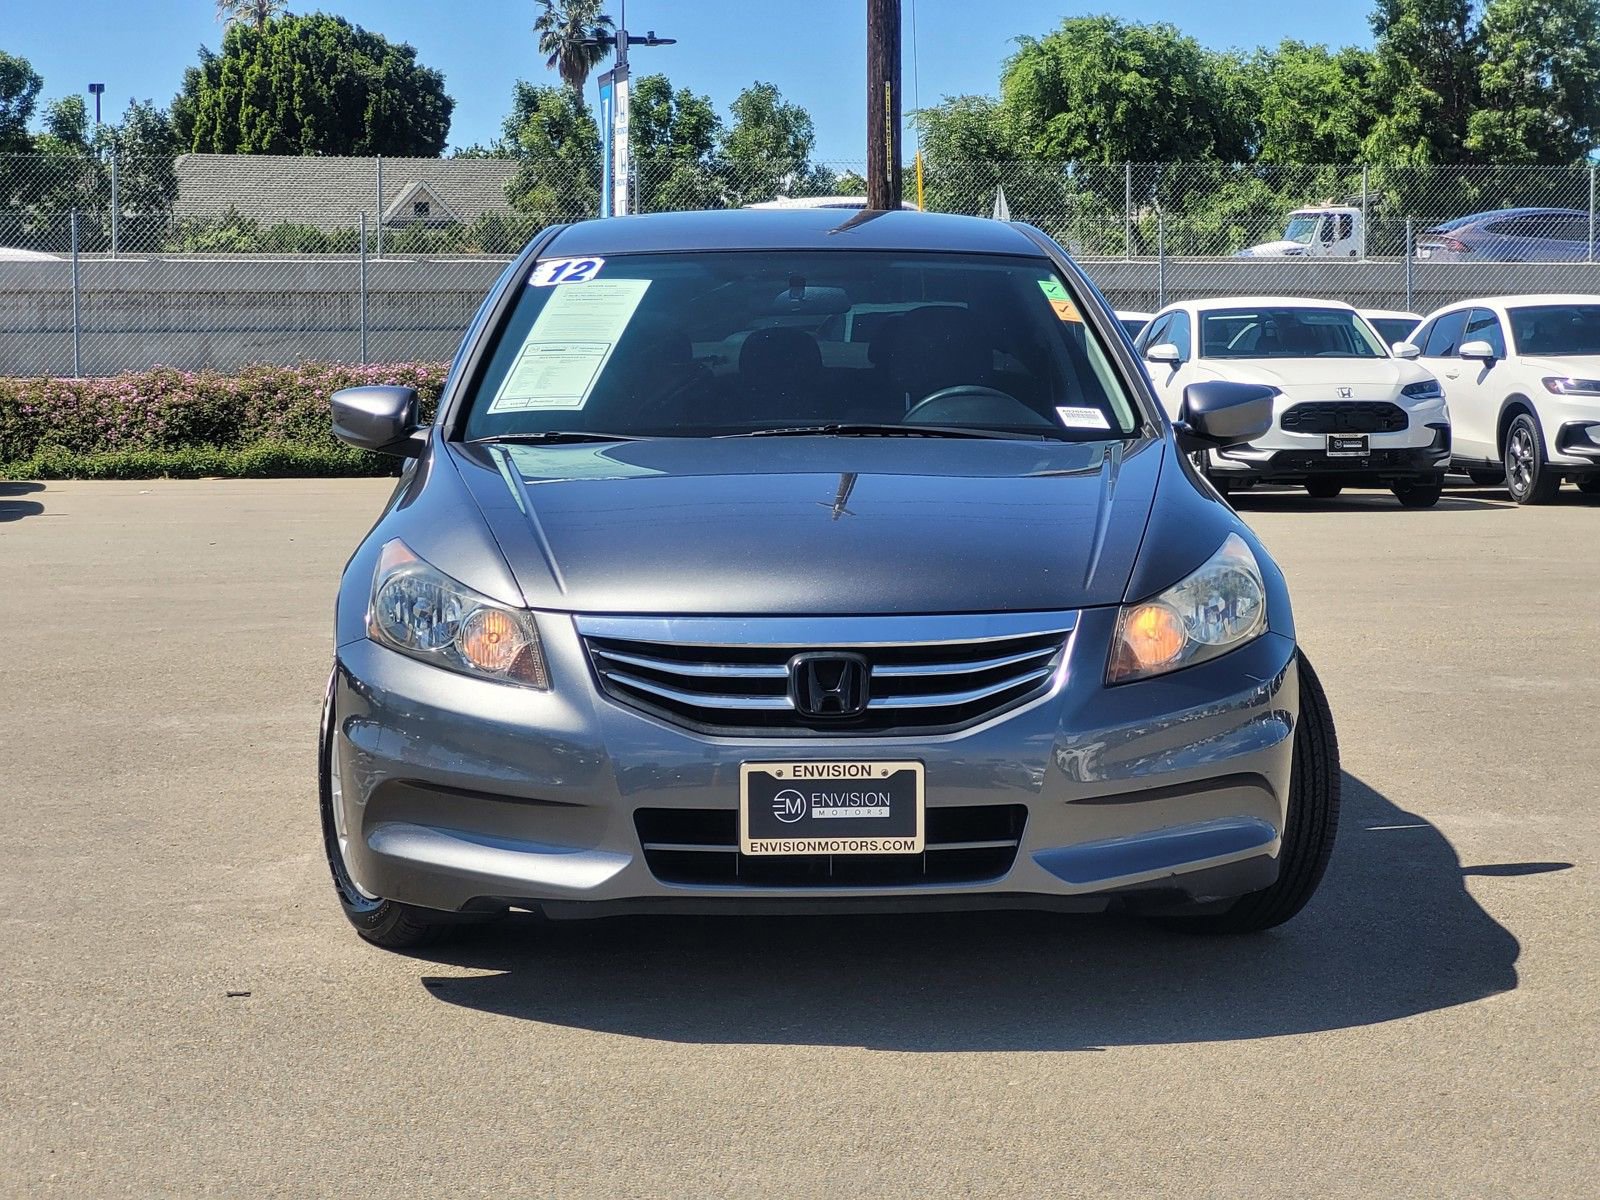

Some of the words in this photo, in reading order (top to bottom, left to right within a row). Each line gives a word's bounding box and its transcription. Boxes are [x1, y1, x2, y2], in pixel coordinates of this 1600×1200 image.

[547, 261, 596, 283] 12
[793, 765, 872, 777] ENVISION
[812, 792, 890, 807] ENVISION
[818, 809, 884, 817] MOTORS
[751, 841, 915, 852] ENVISIONMOTORS.COM
